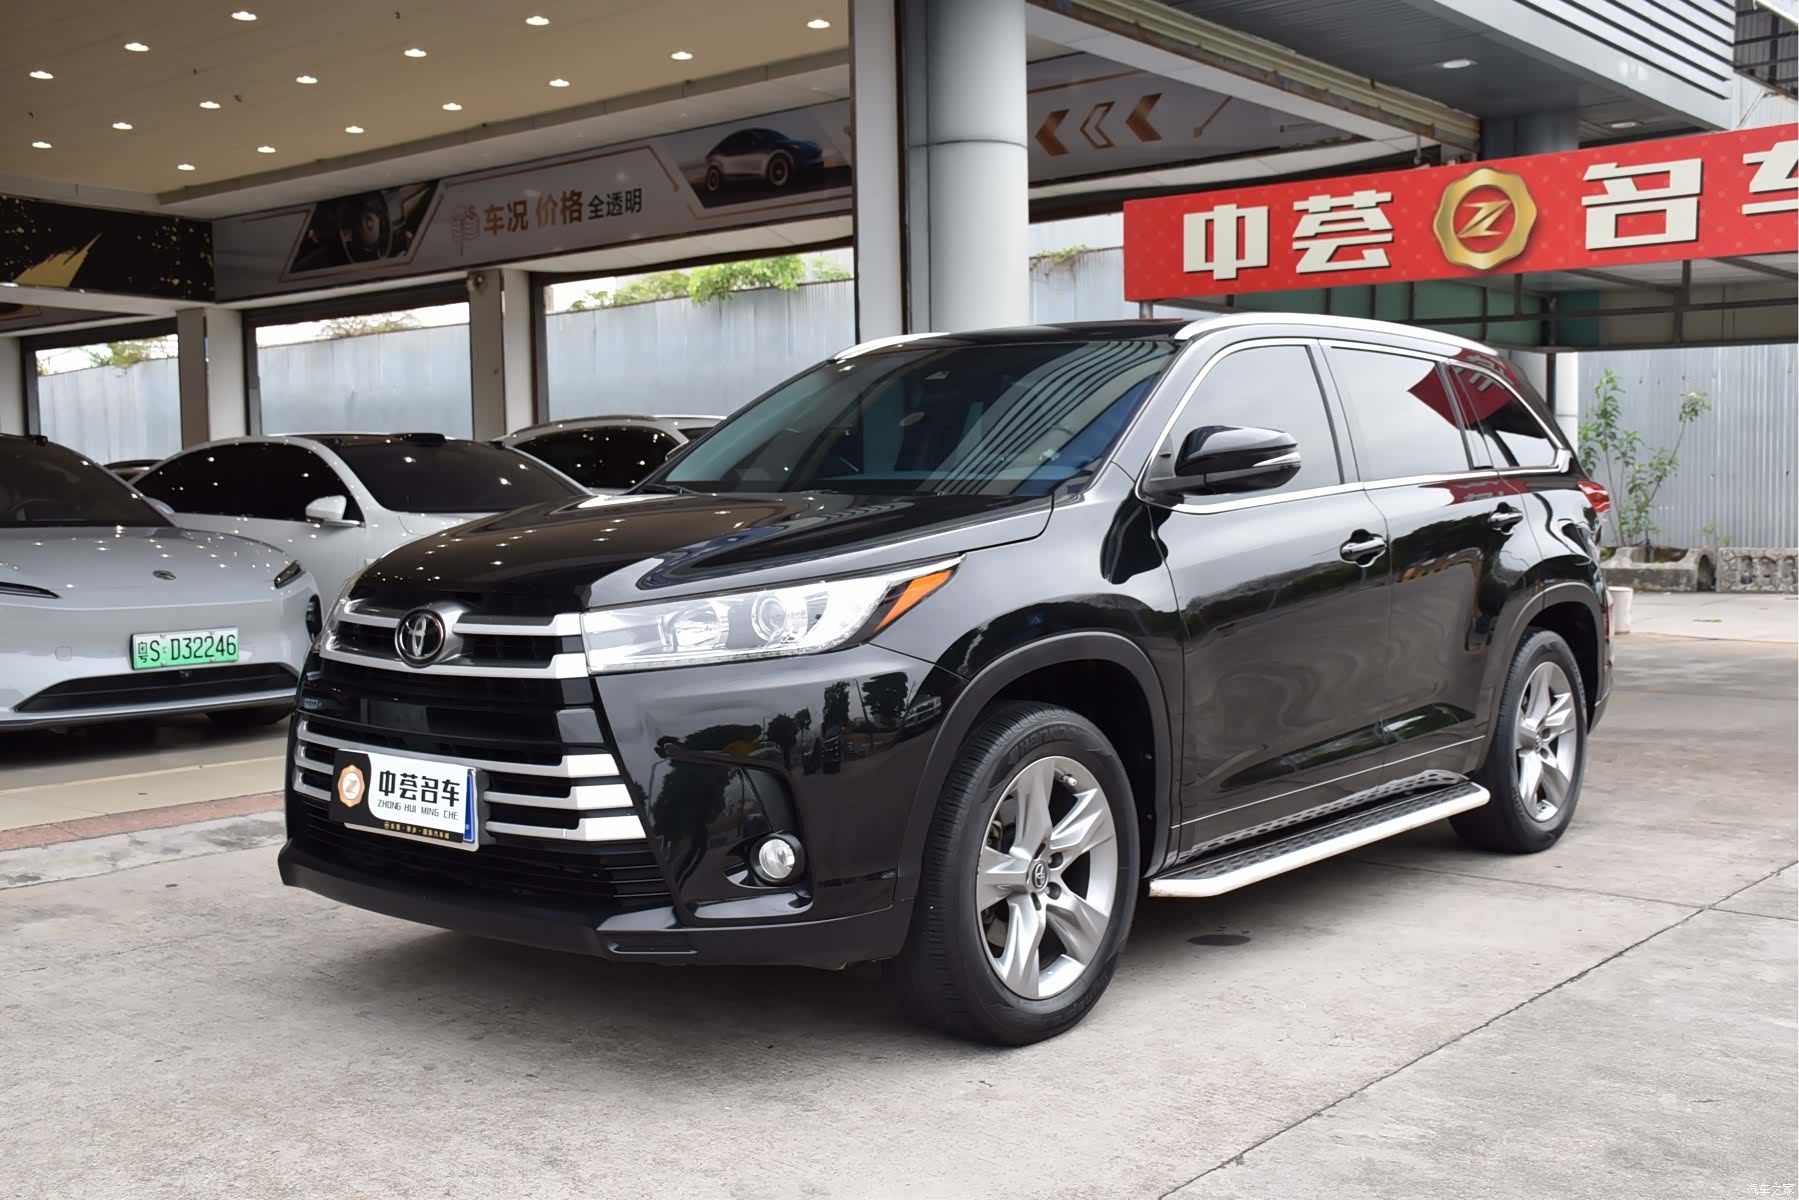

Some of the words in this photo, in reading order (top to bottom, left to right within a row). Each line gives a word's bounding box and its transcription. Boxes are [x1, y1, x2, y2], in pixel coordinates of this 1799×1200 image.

[484, 200, 529, 236] 车况
[535, 190, 582, 227] 价格
[587, 188, 642, 221] 全透明
[1183, 190, 1393, 280] 中荟
[377, 799, 402, 811] ZHONG
[404, 803, 417, 814] HUI
[421, 806, 439, 817] MING
[443, 810, 459, 820] CHE
[378, 770, 461, 807] 中荟名车
